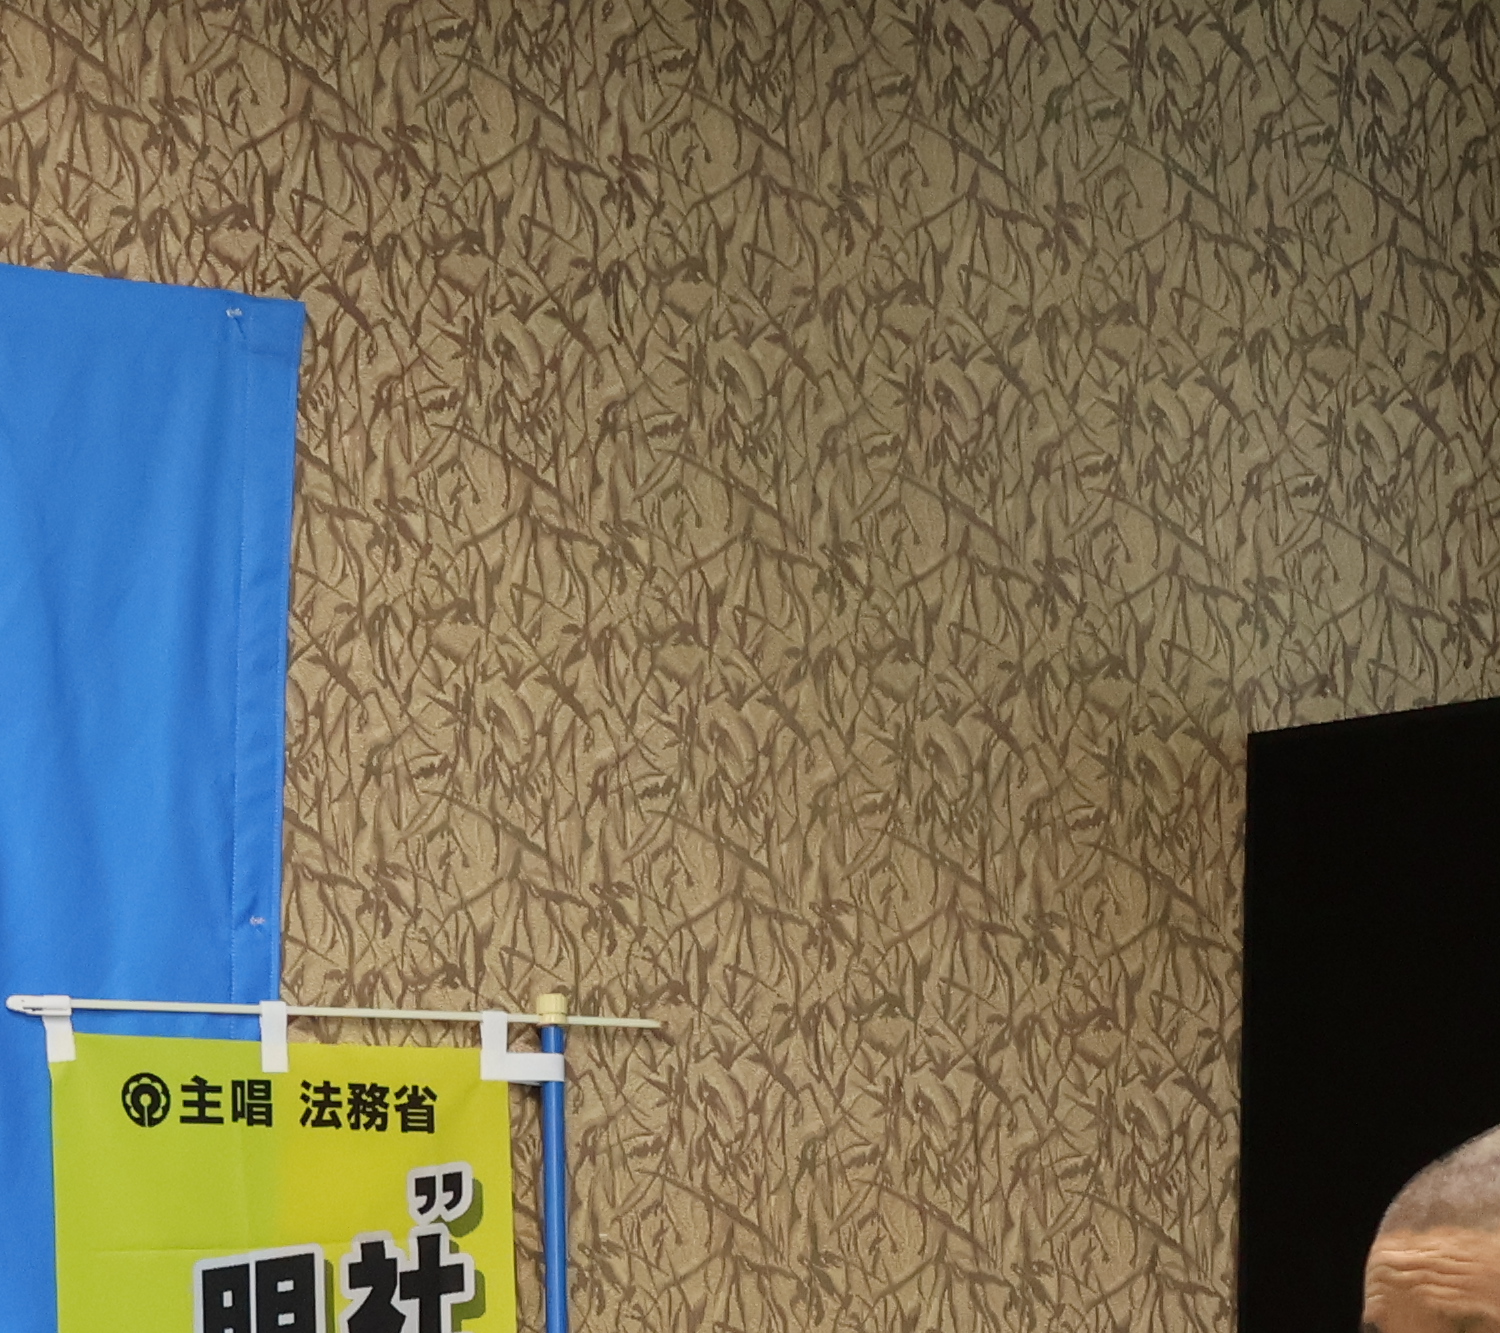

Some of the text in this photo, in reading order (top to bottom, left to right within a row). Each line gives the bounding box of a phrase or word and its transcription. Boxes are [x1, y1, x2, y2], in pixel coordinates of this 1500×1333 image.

[179, 1076, 438, 1134] 主唱 法務省
